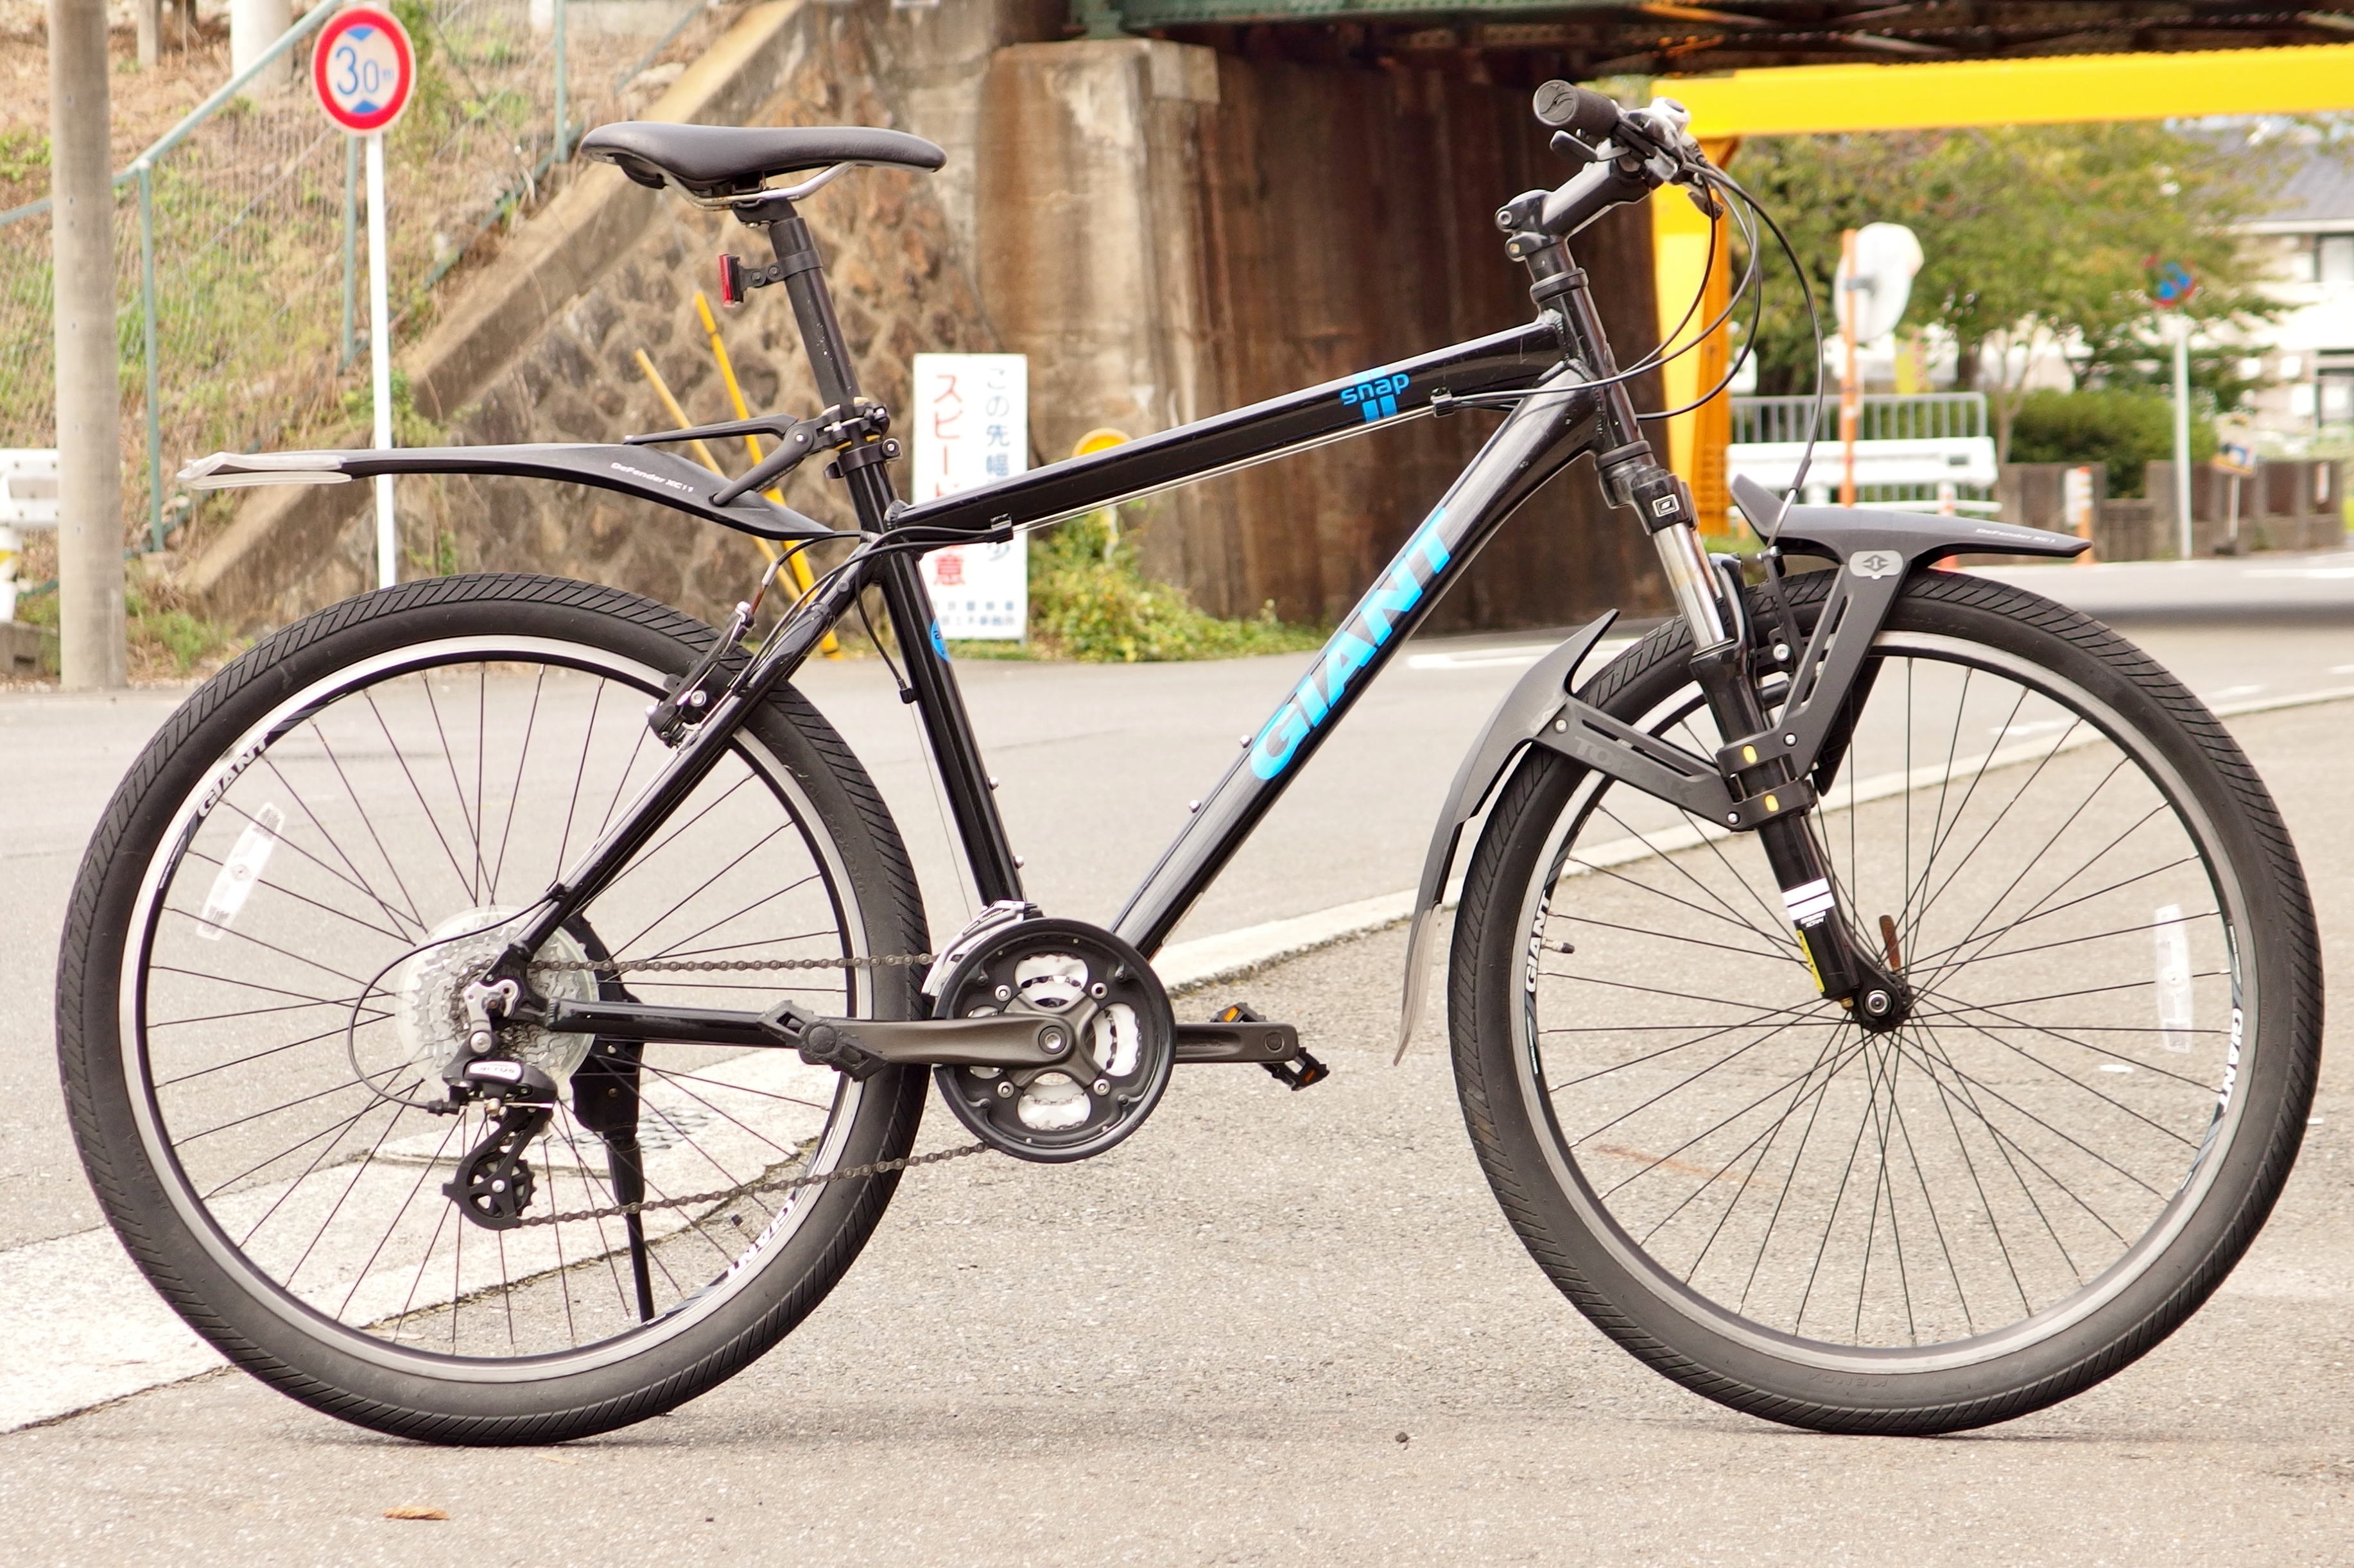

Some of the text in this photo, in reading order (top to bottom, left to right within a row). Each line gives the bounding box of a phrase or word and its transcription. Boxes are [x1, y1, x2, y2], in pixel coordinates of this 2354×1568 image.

[1340, 374, 1411, 406] snap
[1251, 507, 1451, 780] GIANT
[198, 732, 269, 818] GIANT
[1525, 889, 1551, 993] GIANT
